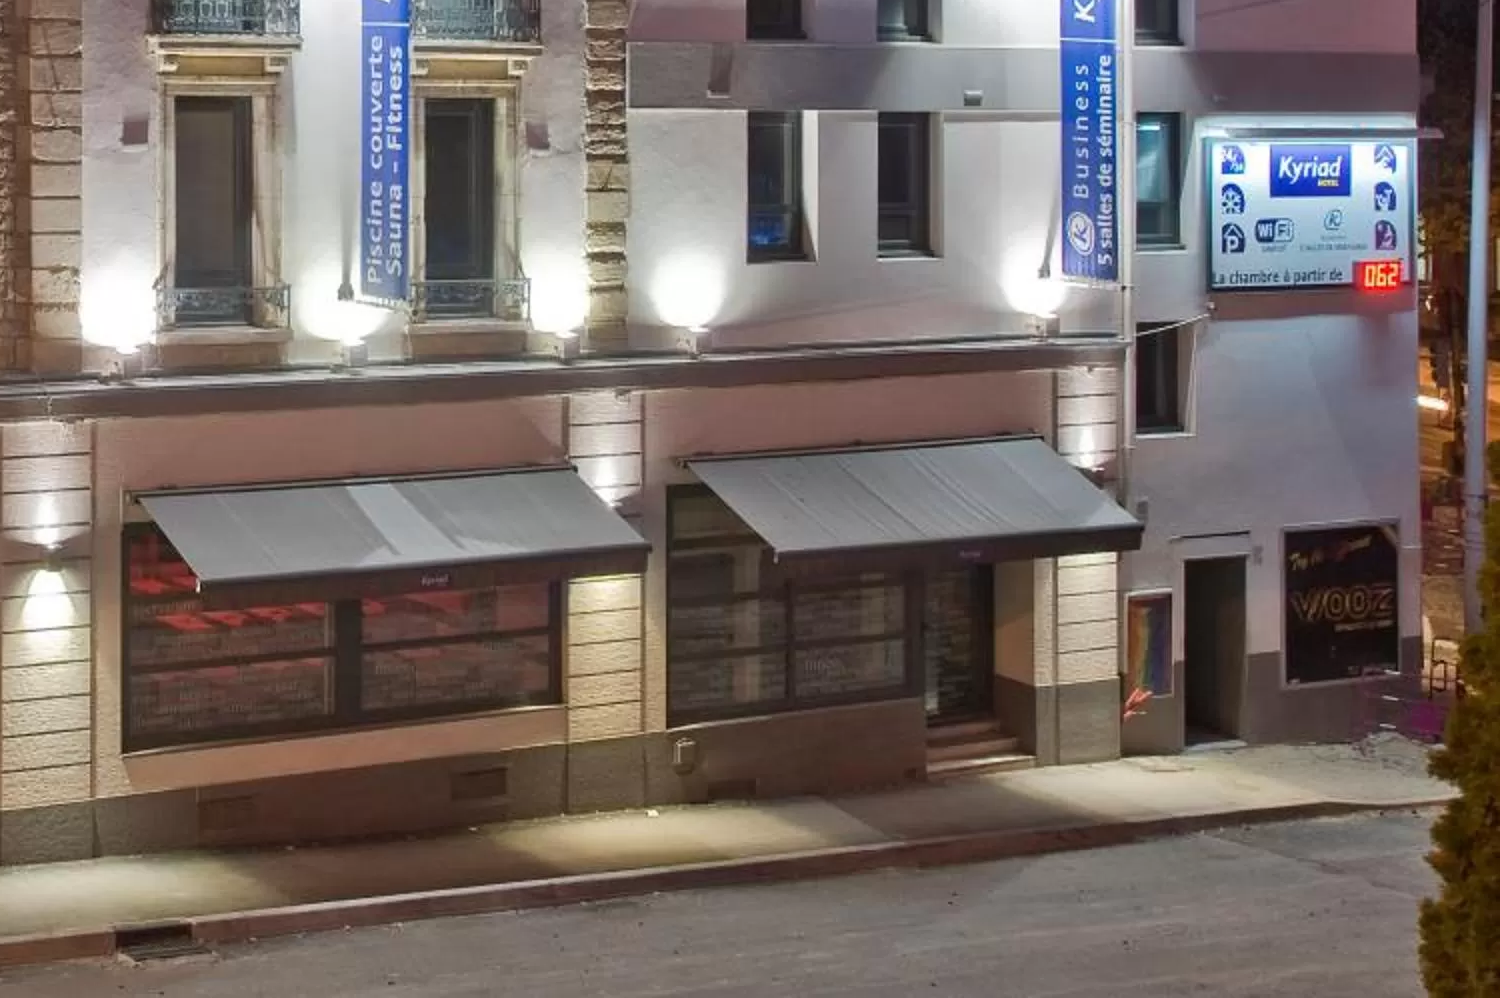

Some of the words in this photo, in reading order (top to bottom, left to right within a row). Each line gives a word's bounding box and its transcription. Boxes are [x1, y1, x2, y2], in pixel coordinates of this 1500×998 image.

[368, 35, 383, 169] couverte
[386, 46, 403, 150] Fitness
[1096, 54, 1112, 157] séminaire
[1073, 64, 1090, 198] Business
[1097, 163, 1113, 186] de
[1279, 155, 1343, 184] Kyriad
[367, 181, 383, 285] Piscine
[386, 184, 403, 277] Sauna
[1097, 193, 1113, 248] salles
[1257, 222, 1291, 238] WiFi
[1097, 253, 1113, 265] 5
[1212, 272, 1225, 285] La
[1229, 270, 1280, 285] chambre
[1283, 268, 1291, 283] à
[1295, 267, 1326, 286] partir
[1329, 266, 1344, 281] de
[1364, 263, 1398, 287] 062
